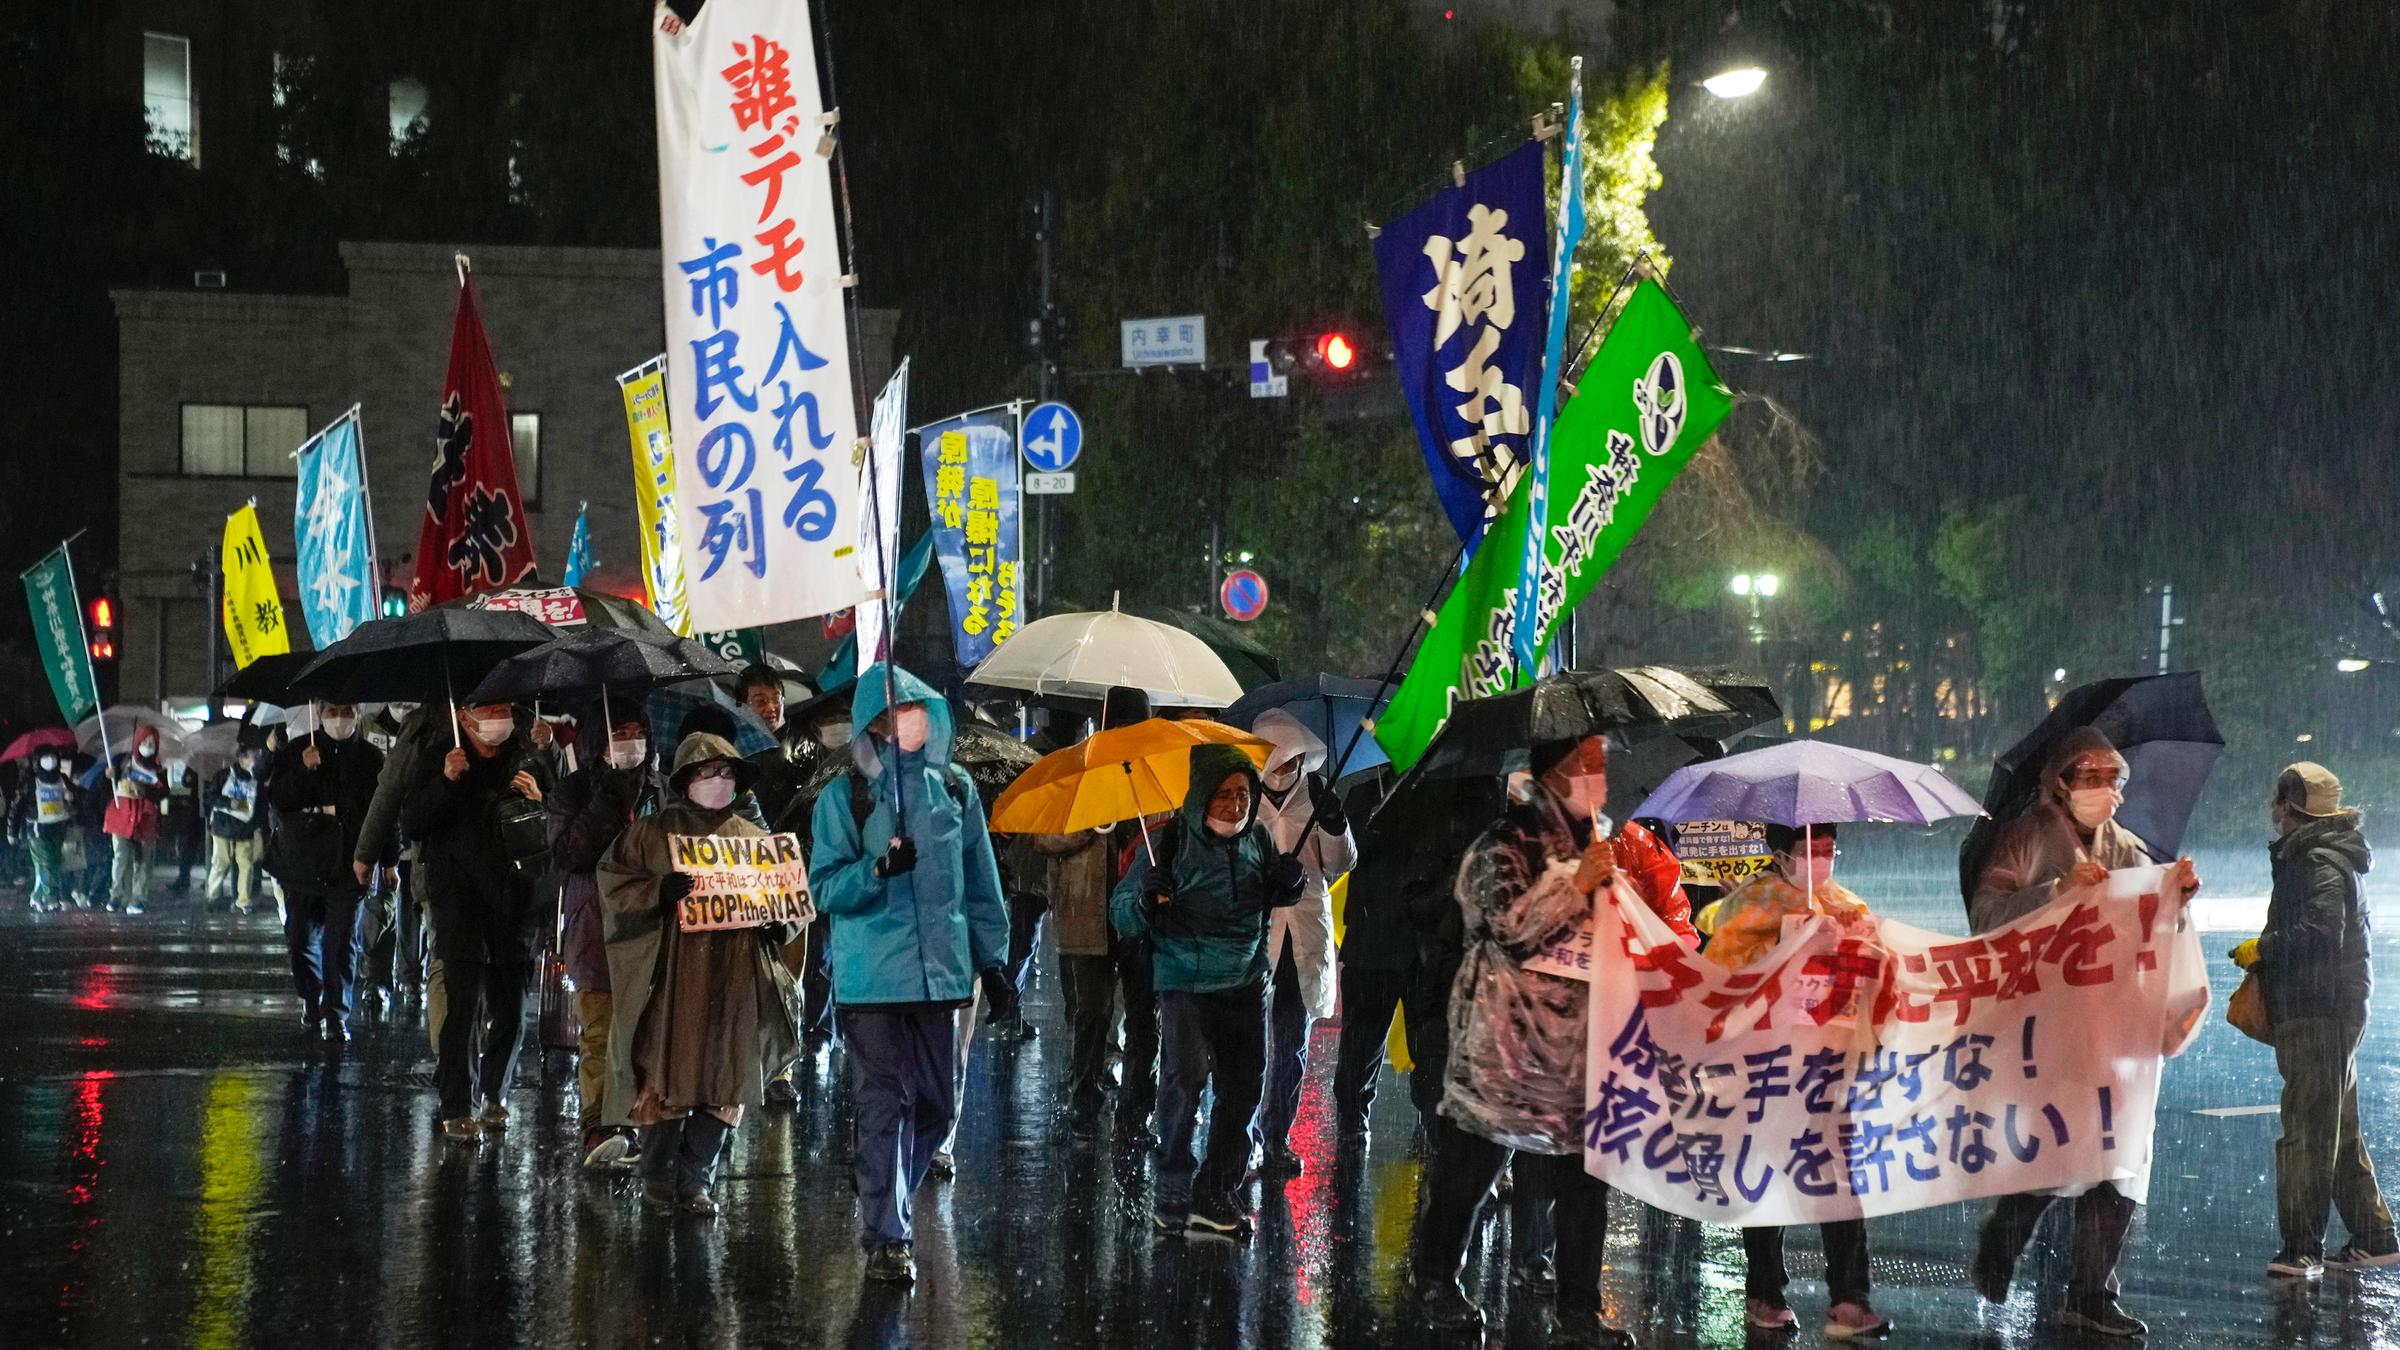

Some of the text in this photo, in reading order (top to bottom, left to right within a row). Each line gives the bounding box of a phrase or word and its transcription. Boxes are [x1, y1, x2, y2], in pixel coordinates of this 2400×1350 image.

[721, 34, 836, 541] 誰デモ入れる
[1131, 323, 1195, 347] 内幸町
[678, 237, 767, 581] 市民の列
[1680, 843, 1765, 857] 原発に手を出すな!
[690, 867, 802, 892] 力で平和はつくれない!
